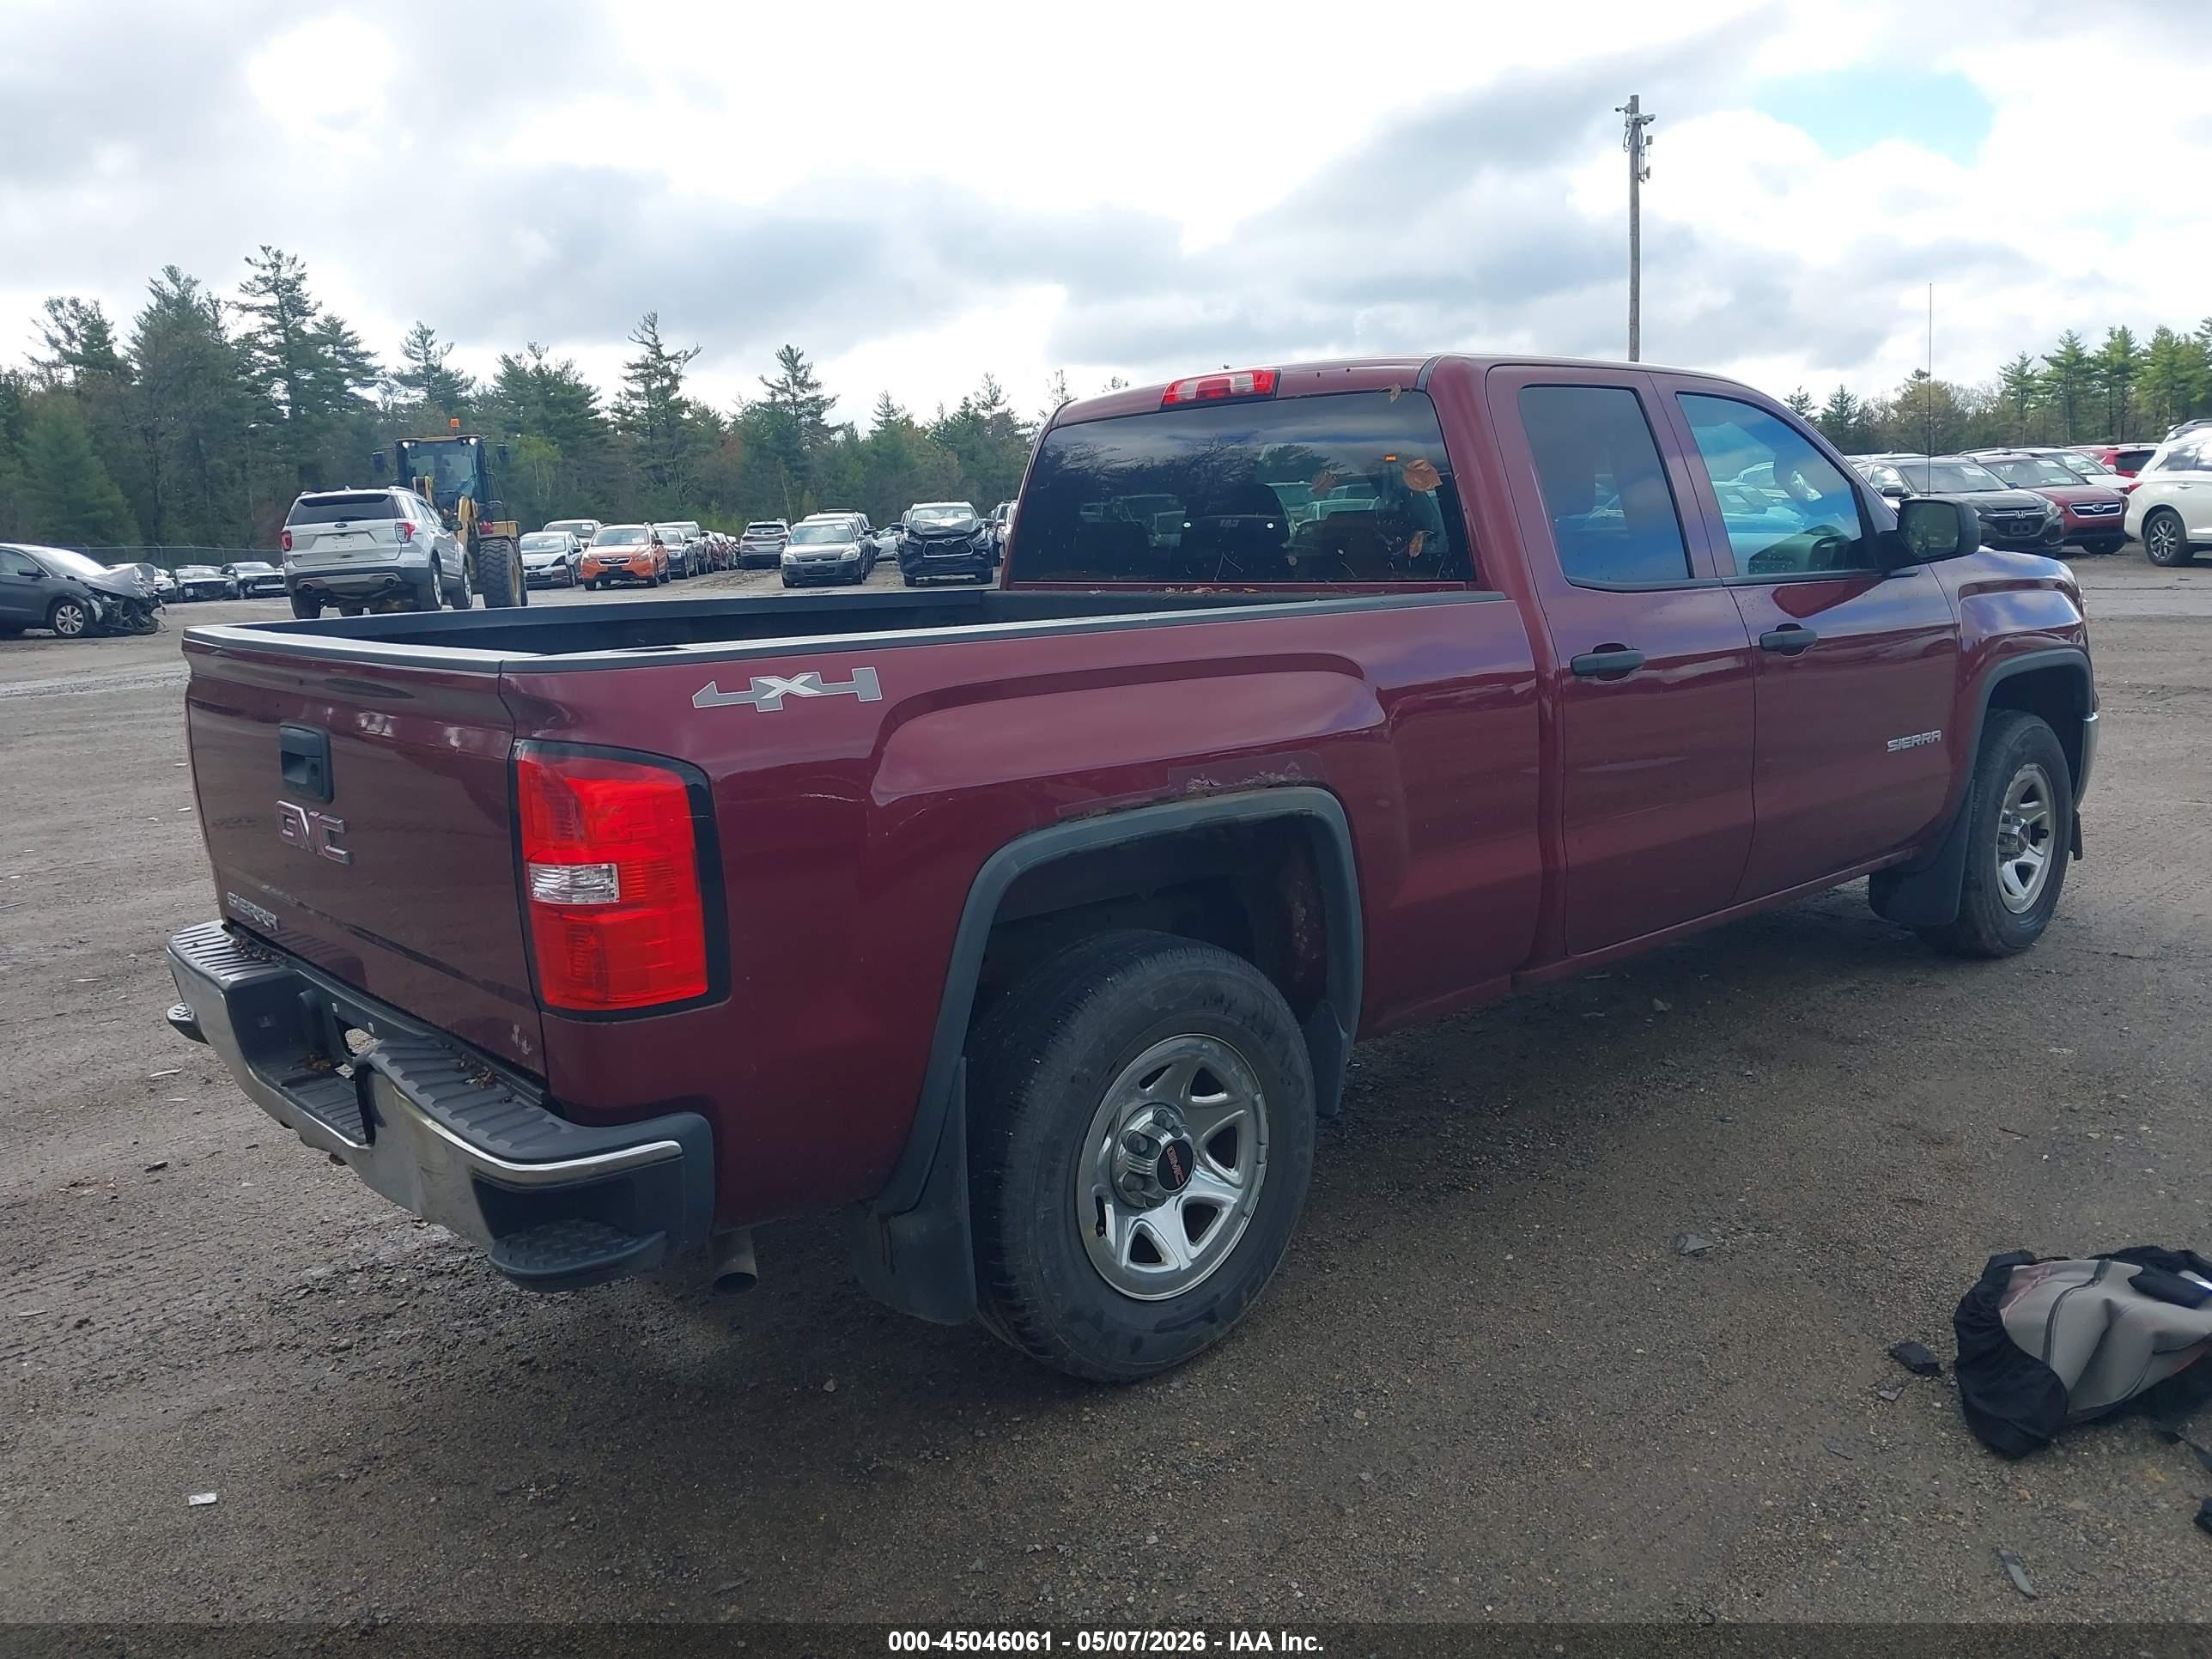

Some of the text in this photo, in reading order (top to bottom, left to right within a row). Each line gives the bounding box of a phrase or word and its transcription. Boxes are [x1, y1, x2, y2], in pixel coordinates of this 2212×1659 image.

[1887, 730, 1942, 752] SIERRA
[275, 799, 352, 866] GMC
[226, 890, 279, 931] SIERRA
[1166, 1145, 1185, 1186] GMC
